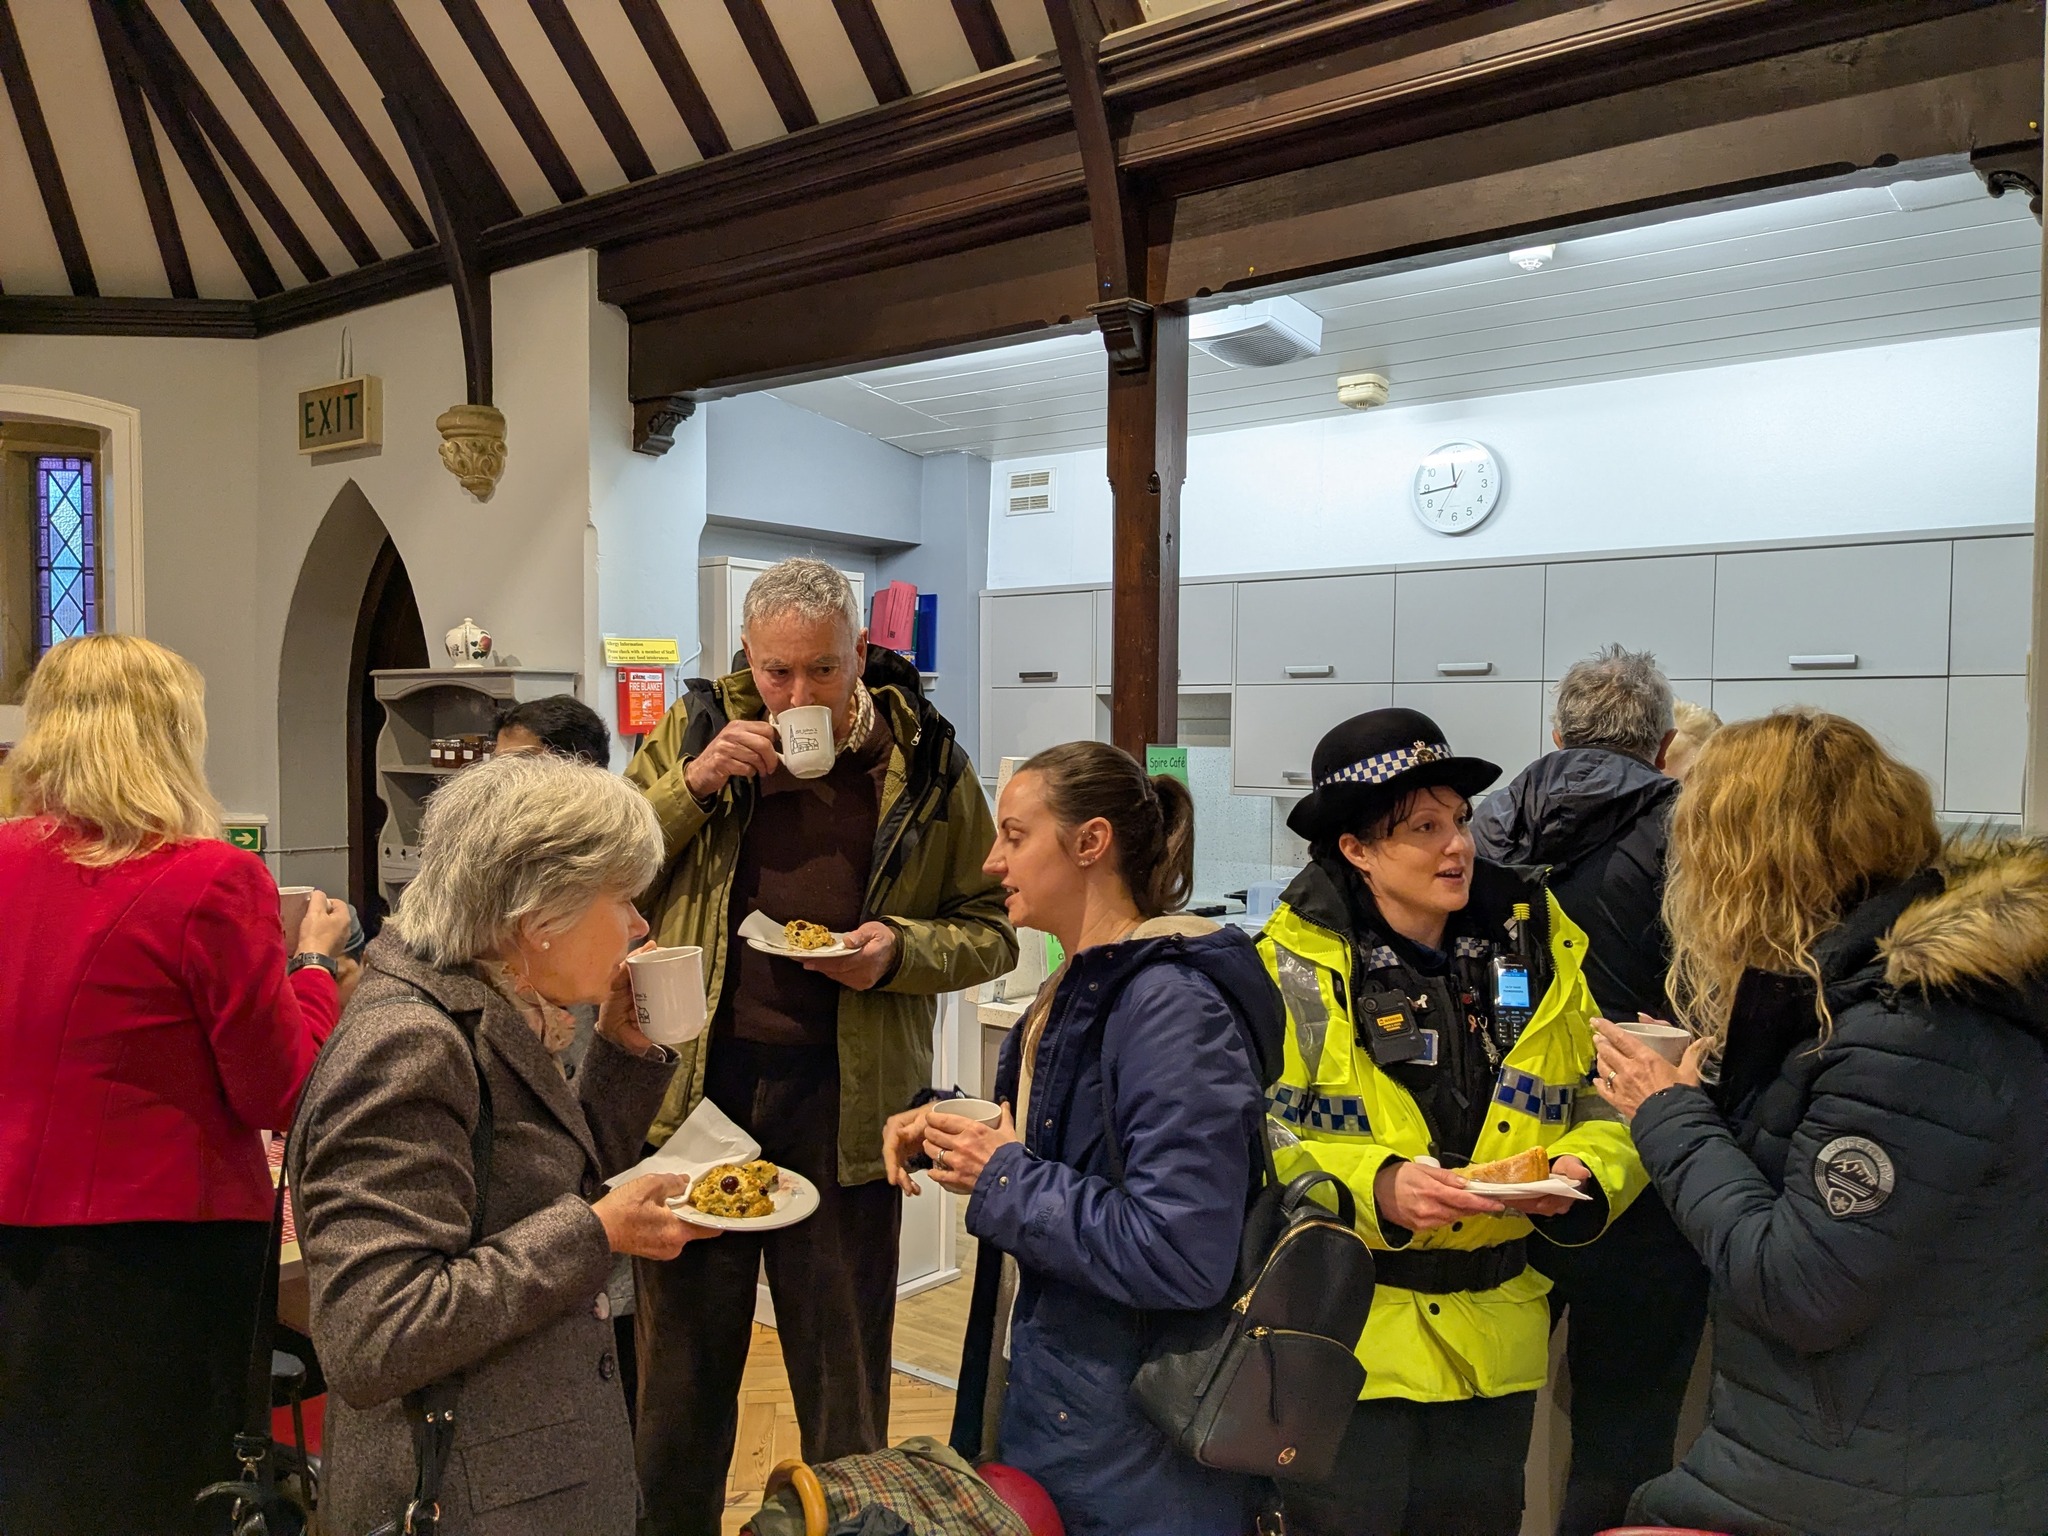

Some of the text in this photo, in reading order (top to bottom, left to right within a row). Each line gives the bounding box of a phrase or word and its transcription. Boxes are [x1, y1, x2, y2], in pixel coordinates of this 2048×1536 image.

[305, 393, 357, 438] EXIT
[1427, 468, 1436, 477] 10
[1478, 464, 1484, 473] 2
[1481, 479, 1488, 488] 3
[1424, 484, 1430, 493] 9
[1427, 499, 1433, 508] 8
[1477, 495, 1483, 503] 4
[1437, 509, 1443, 518] 7
[1466, 507, 1473, 516] 5
[1451, 512, 1458, 521] 6
[629, 682, 663, 691] FIRE BLANKET
[1149, 756, 1186, 771] Spire Café
